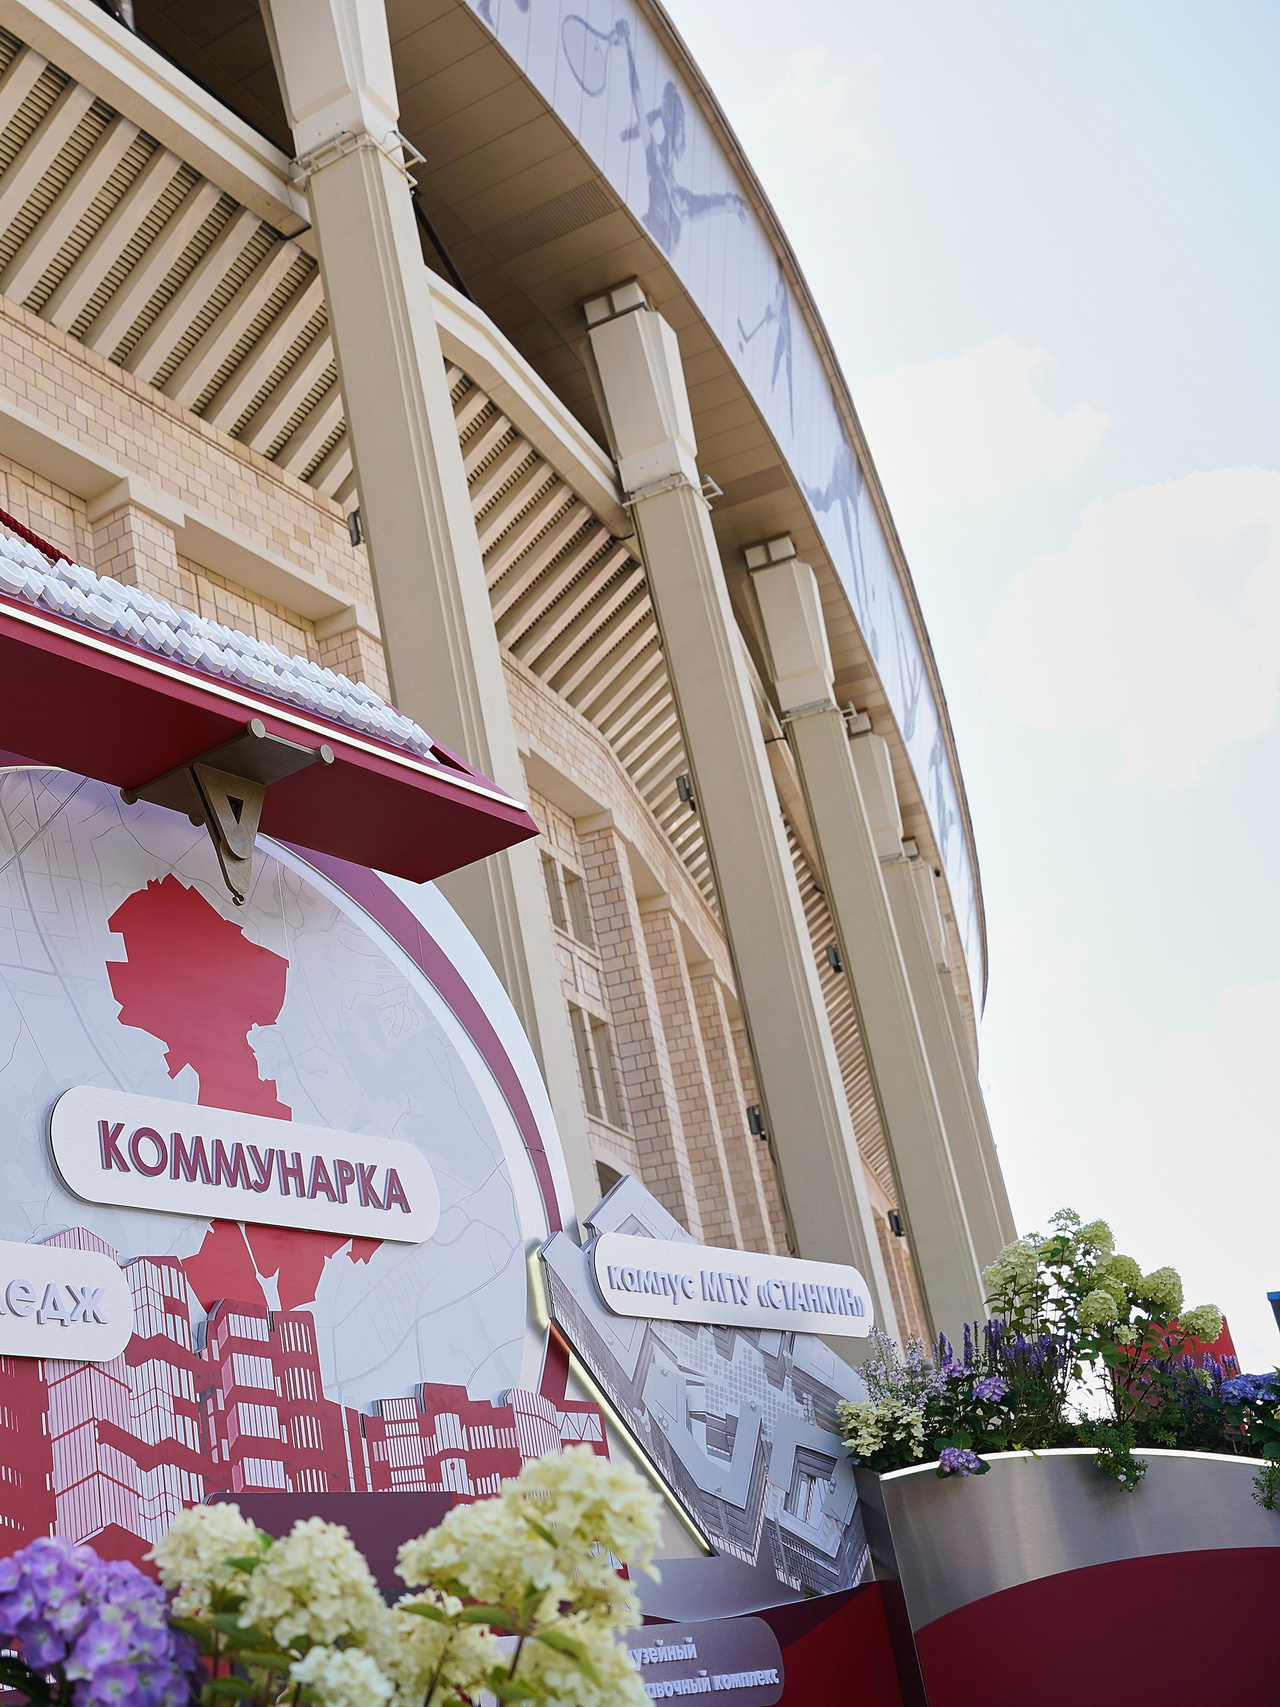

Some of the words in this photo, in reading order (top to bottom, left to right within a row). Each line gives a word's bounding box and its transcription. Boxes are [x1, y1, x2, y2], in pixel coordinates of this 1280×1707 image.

[98, 1119, 412, 1213] КОММУНАРКА
[608, 1264, 696, 1305] кампус
[700, 1270, 752, 1307] МГТУ
[713, 1668, 779, 1690] комплекс
